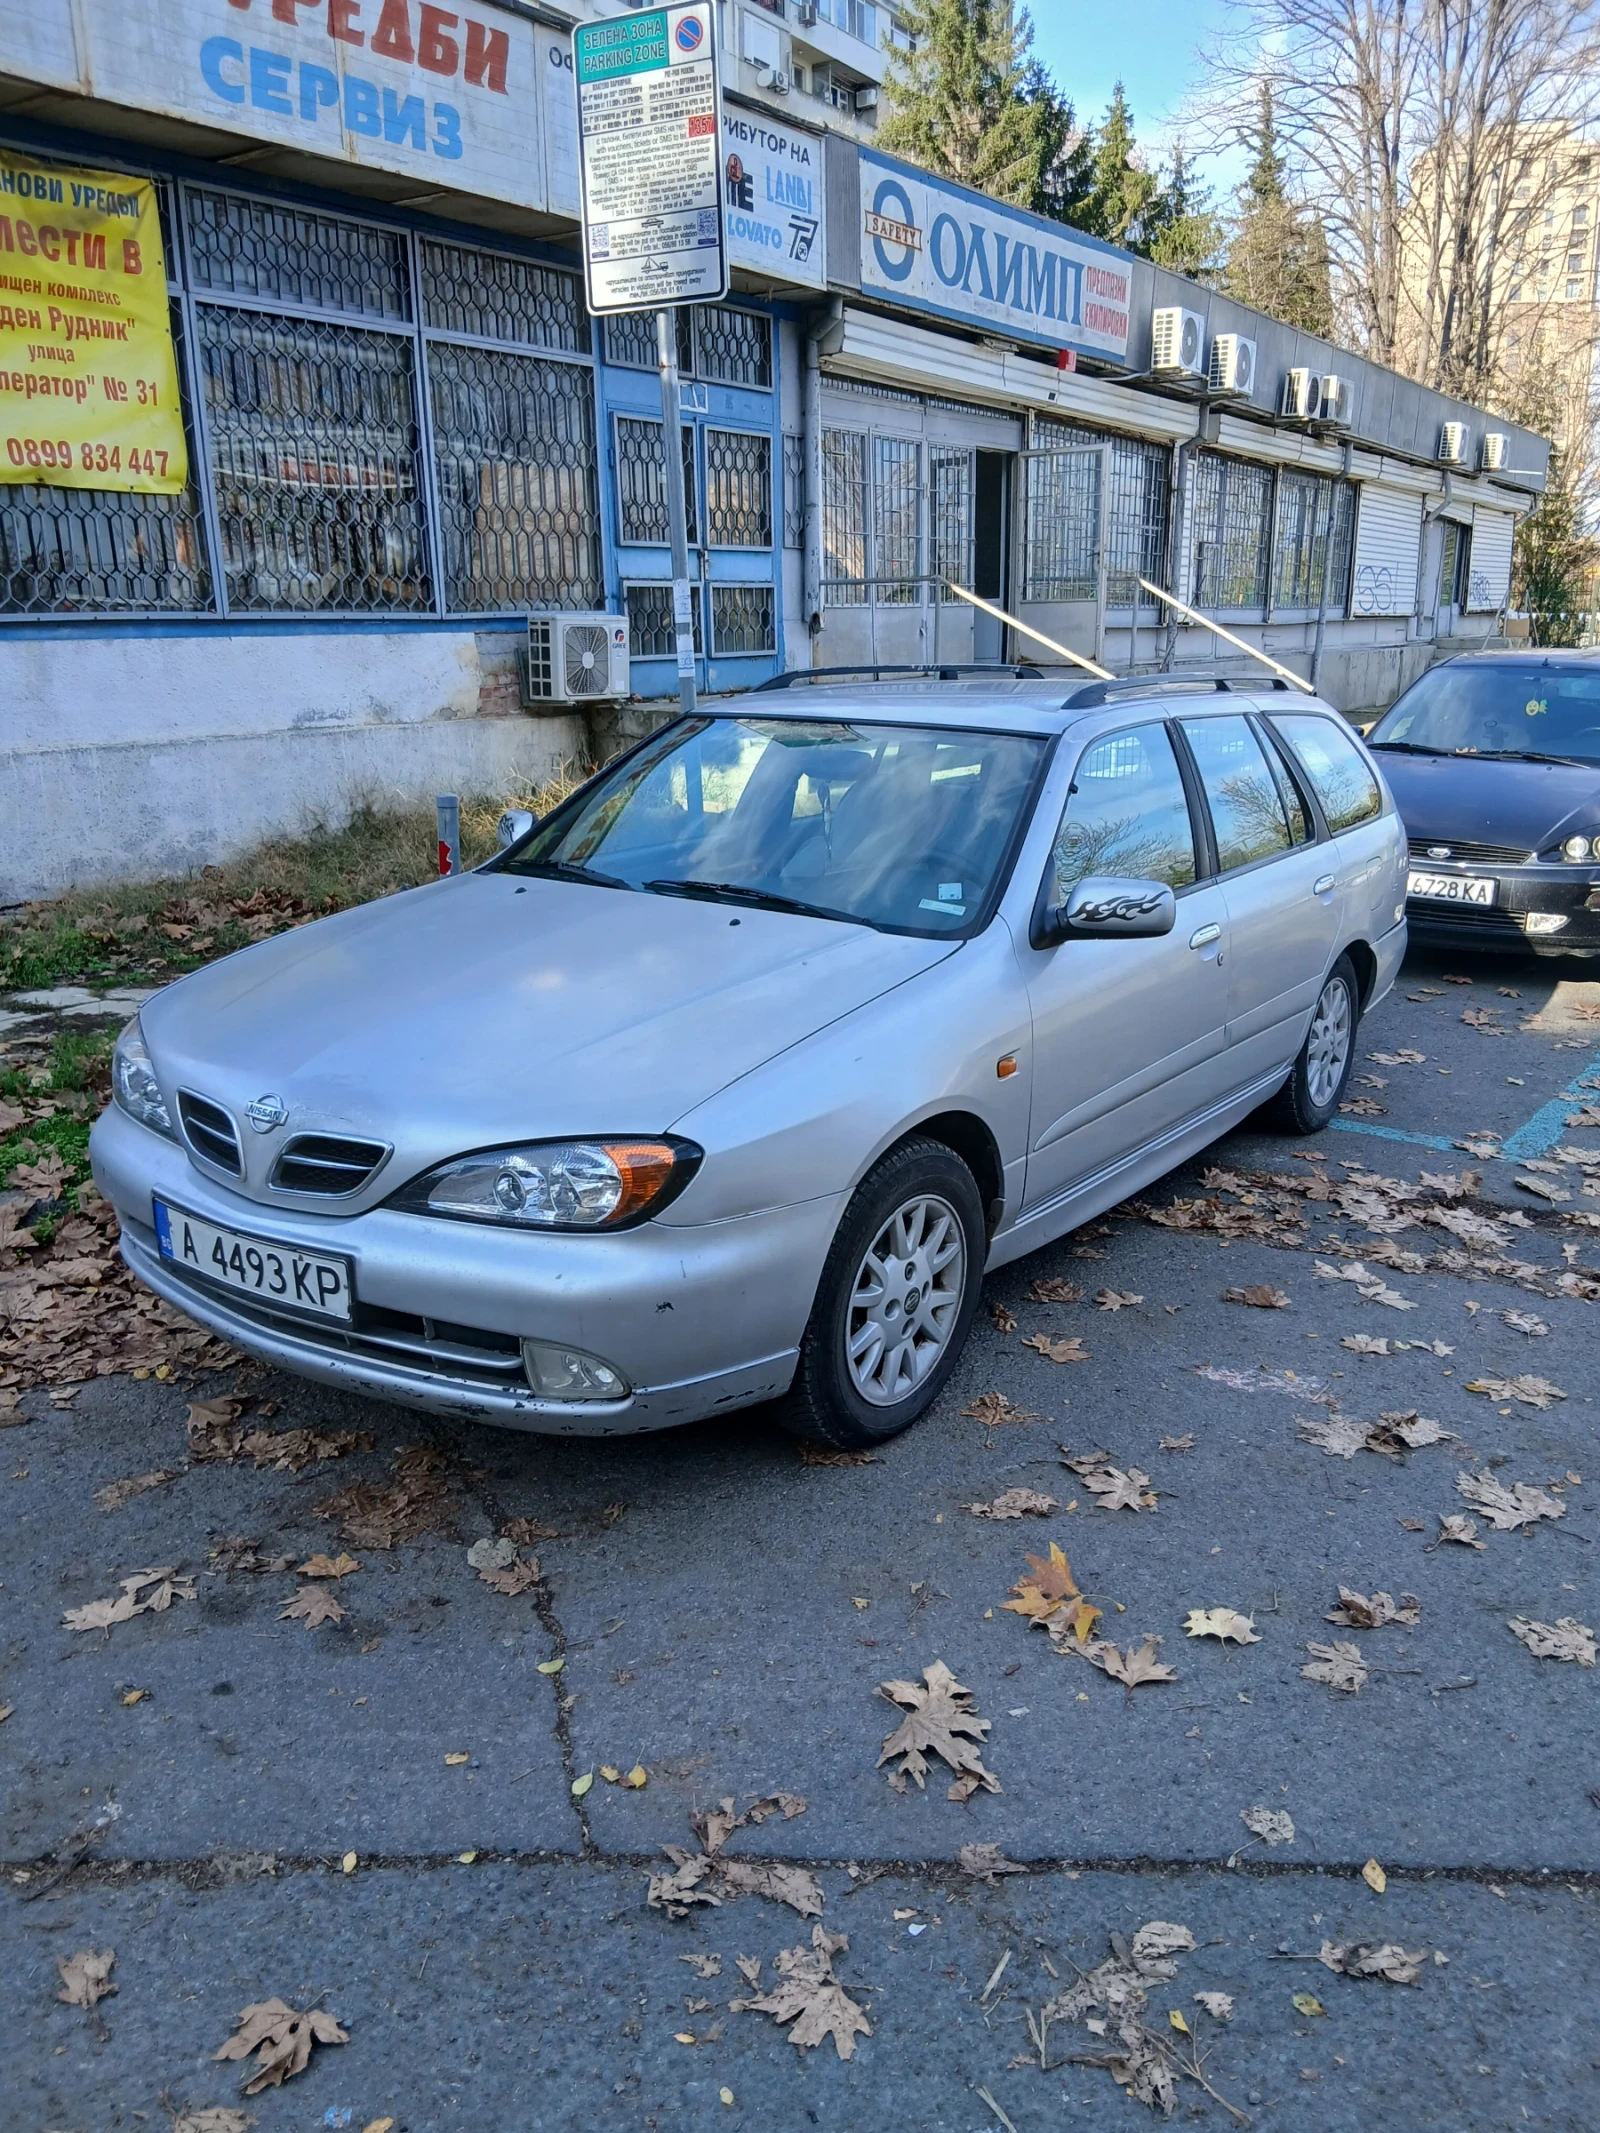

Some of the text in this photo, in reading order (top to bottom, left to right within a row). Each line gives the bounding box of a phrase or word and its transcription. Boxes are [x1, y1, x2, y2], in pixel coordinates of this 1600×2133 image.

[584, 23, 663, 50] ЗЕЛЕНА ЗОНА
[583, 41, 666, 73] PARKING ZONE
[200, 36, 463, 160] СЕРВИЗ
[690, 117, 714, 138] 1357
[791, 143, 811, 166] НА
[70, 182, 140, 219] УРЕДБИ
[728, 213, 782, 250] LOVATO
[872, 217, 916, 245] SAFETY
[930, 212, 1086, 326] ОЛИМП
[48, 282, 121, 306] комплекс
[48, 306, 136, 342] Рудник"
[27, 344, 75, 364] улица
[136, 379, 158, 406] 31
[6, 438, 169, 477] 0899 834 447
[1412, 878, 1487, 902] 6728 KA
[248, 1104, 280, 1120] NISSAN
[160, 1235, 172, 1250] BG
[184, 1222, 341, 1307] A 4493 KP
